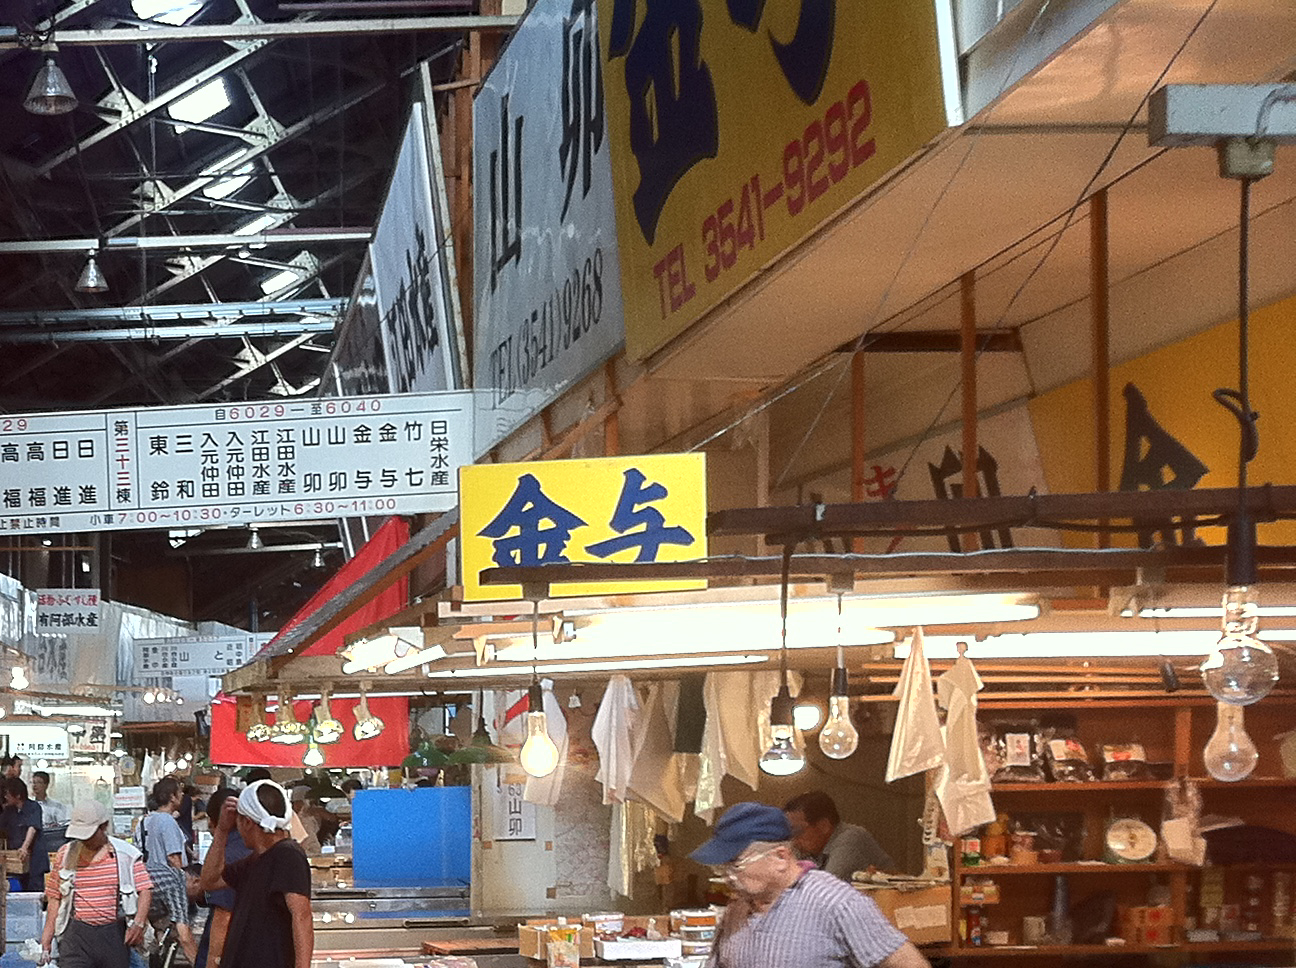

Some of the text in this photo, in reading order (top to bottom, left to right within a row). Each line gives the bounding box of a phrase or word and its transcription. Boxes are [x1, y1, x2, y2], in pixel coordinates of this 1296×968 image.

[653, 80, 876, 320] TEL 3541-9292
[476, 468, 695, 566] 金与
